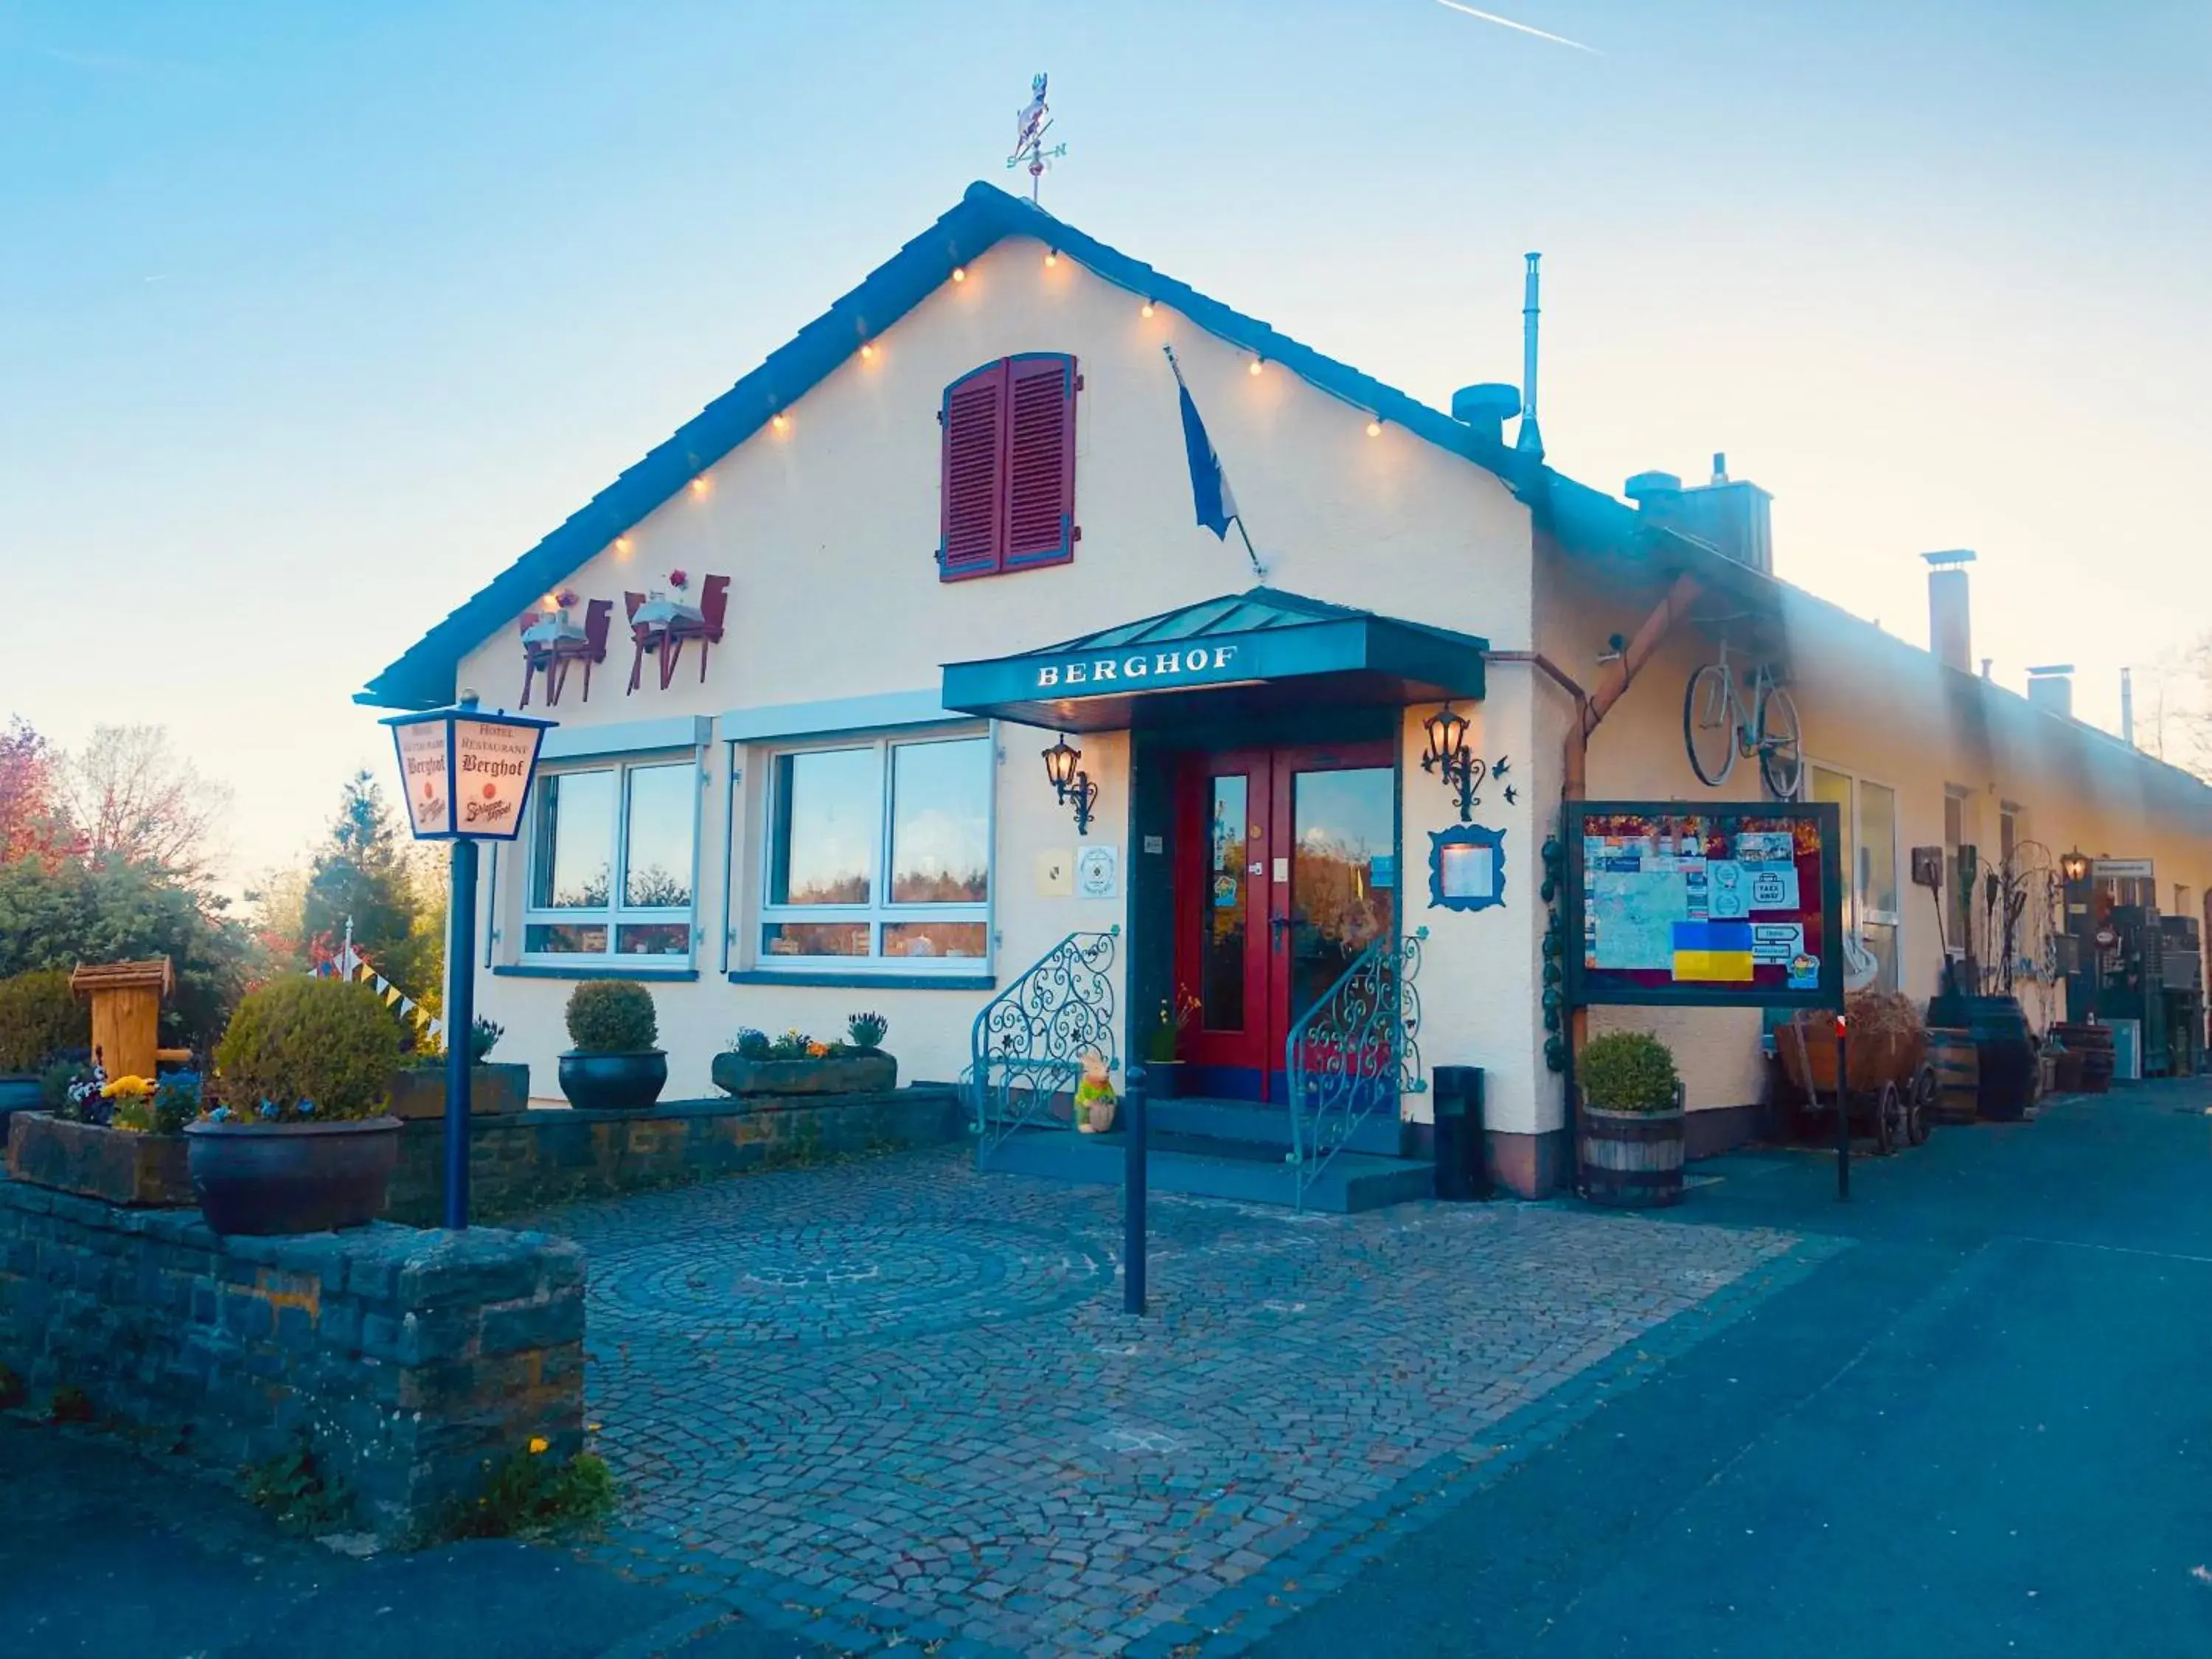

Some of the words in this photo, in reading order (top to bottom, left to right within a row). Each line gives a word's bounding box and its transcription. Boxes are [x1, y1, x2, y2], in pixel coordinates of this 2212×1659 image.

[1037, 645, 1238, 686] BERGHOF
[479, 723, 514, 738] HOTEL
[462, 737, 528, 754] RESTAURANT
[462, 754, 524, 777] Berghof
